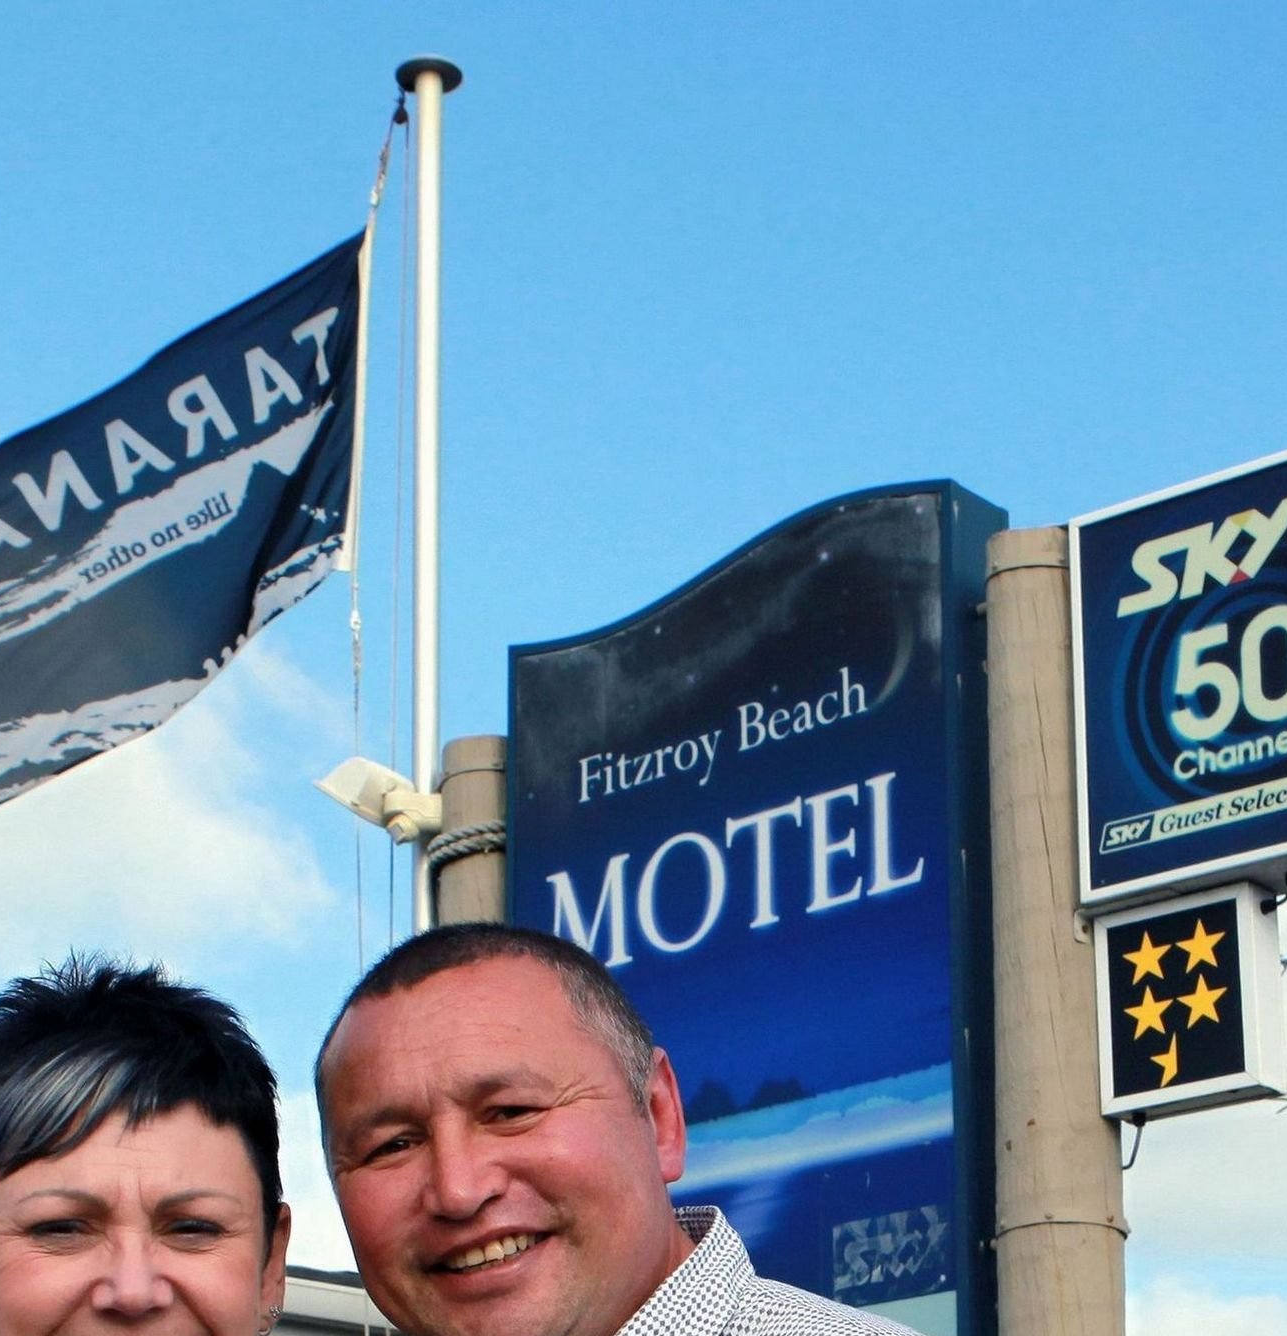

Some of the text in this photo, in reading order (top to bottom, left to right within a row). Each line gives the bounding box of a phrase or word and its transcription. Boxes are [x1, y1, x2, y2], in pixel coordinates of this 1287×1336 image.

[578, 666, 868, 803] Fitzroy Beach
[546, 771, 925, 969] MOTEL
[1105, 819, 1151, 847] SKY
[1159, 803, 1224, 836] Guest
